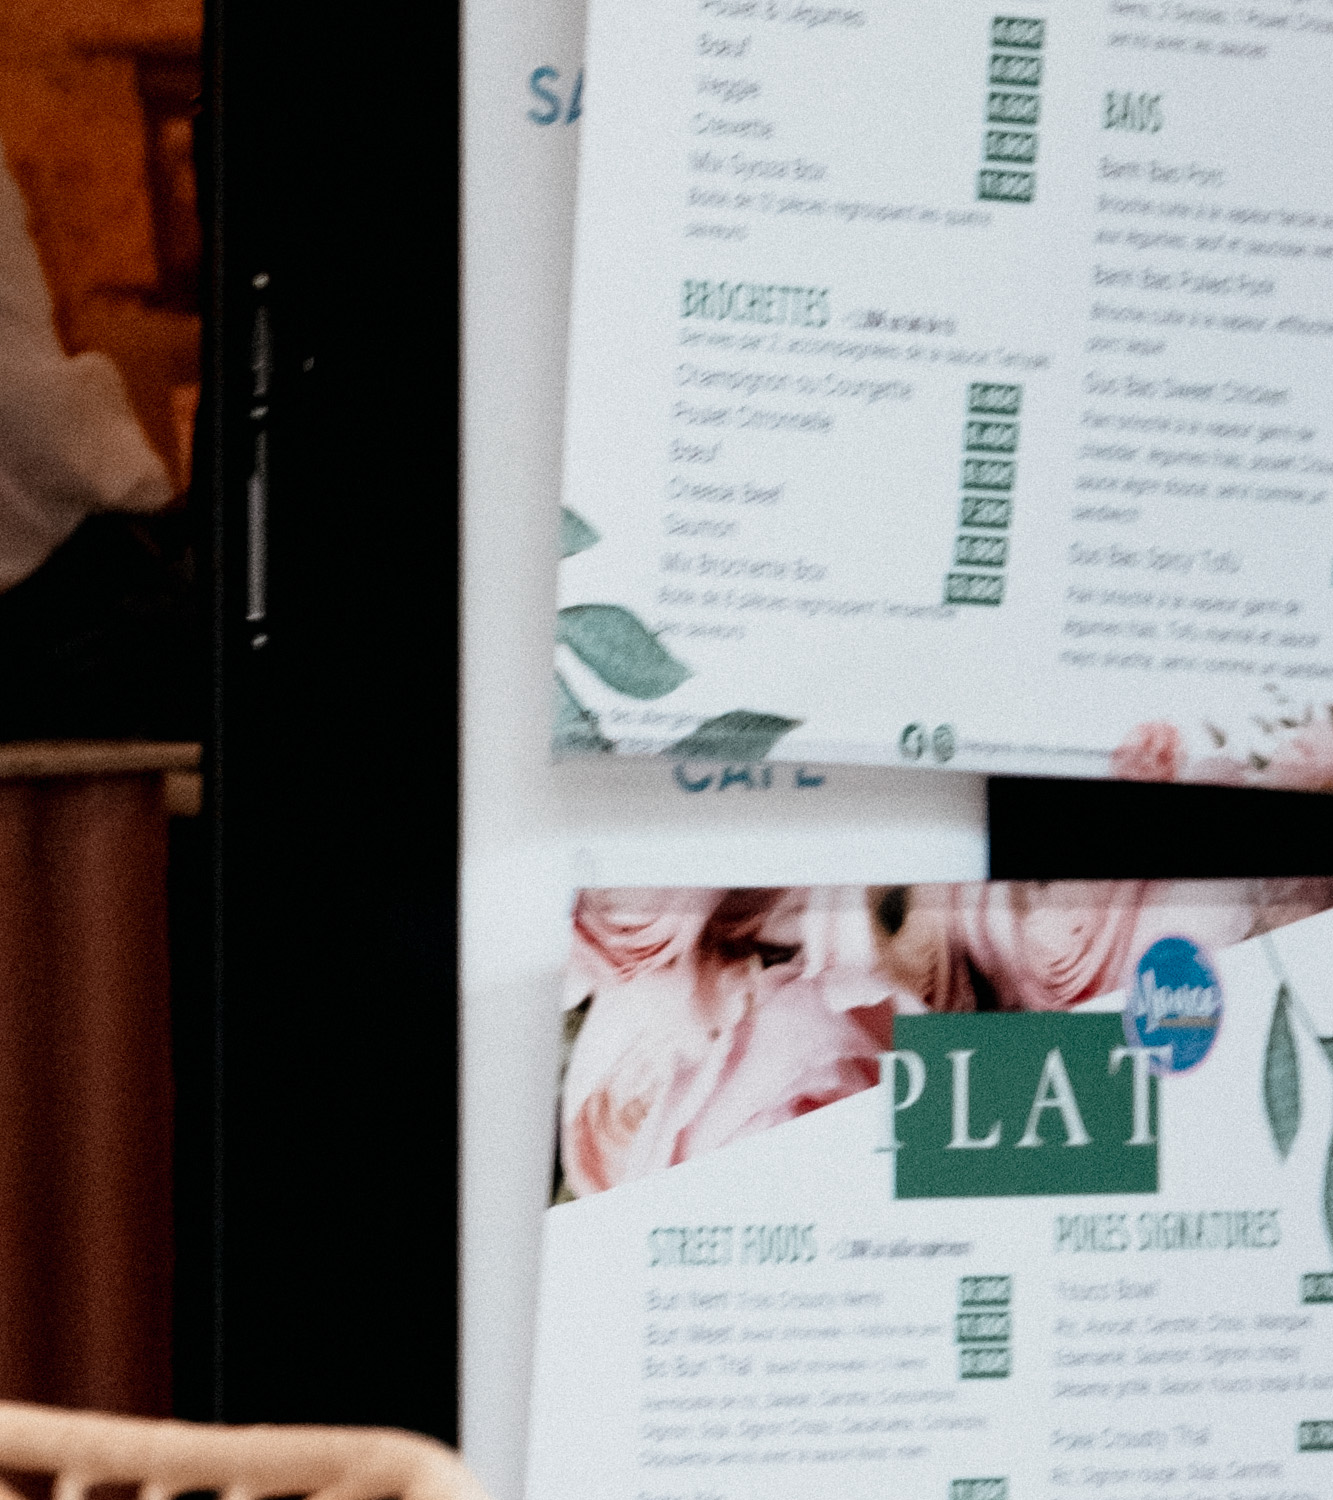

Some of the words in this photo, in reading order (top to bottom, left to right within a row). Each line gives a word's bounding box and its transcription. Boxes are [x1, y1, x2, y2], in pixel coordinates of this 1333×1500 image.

[1103, 90, 1163, 134] BAOS
[681, 278, 830, 329] BROCHETTES
[874, 1044, 1173, 1152] PLAT
[649, 1224, 734, 1268] STREET
[742, 1222, 817, 1265] FOODS
[1054, 1213, 1129, 1254] POKES
[1136, 1208, 1281, 1252] SIGNATURES
